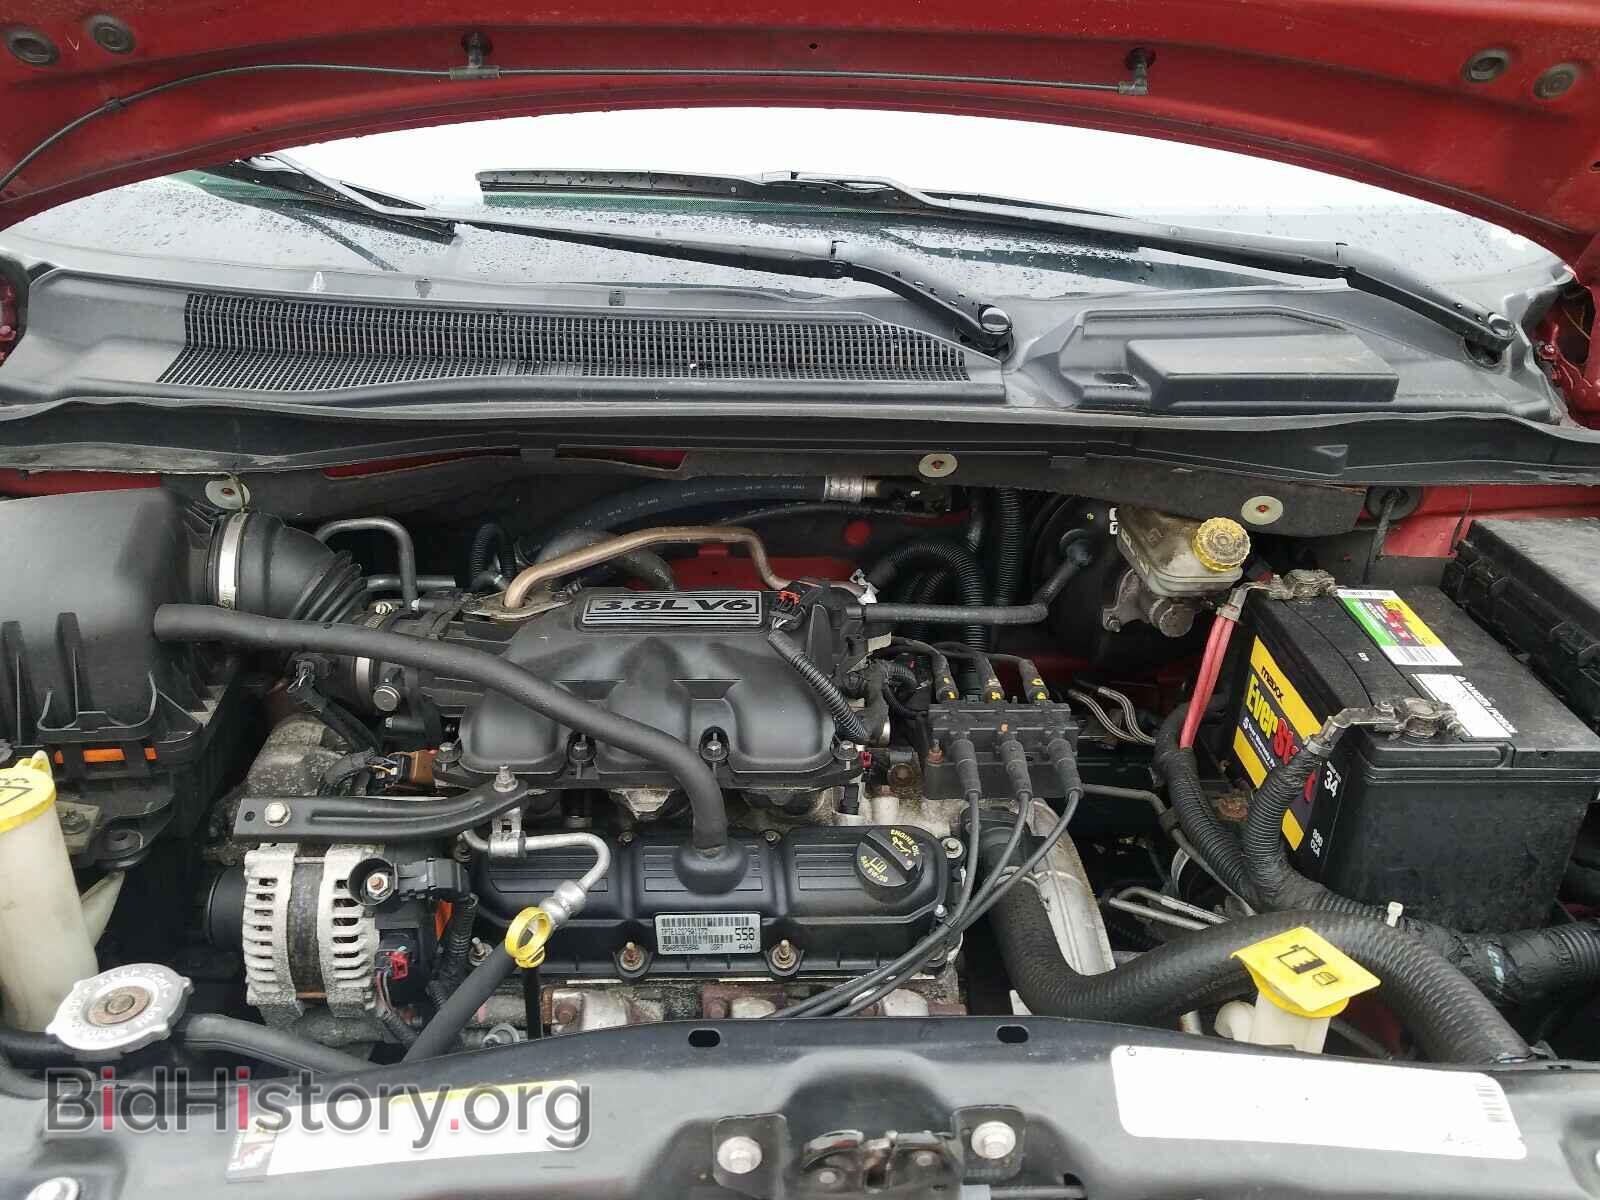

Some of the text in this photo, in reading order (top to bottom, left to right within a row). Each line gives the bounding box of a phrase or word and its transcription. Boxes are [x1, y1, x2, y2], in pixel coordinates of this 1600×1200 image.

[594, 598, 753, 611] 3.8L V6
[1324, 770, 1338, 798] 34
[890, 829, 920, 857] ENGINE OIL
[738, 943, 753, 951] AA
